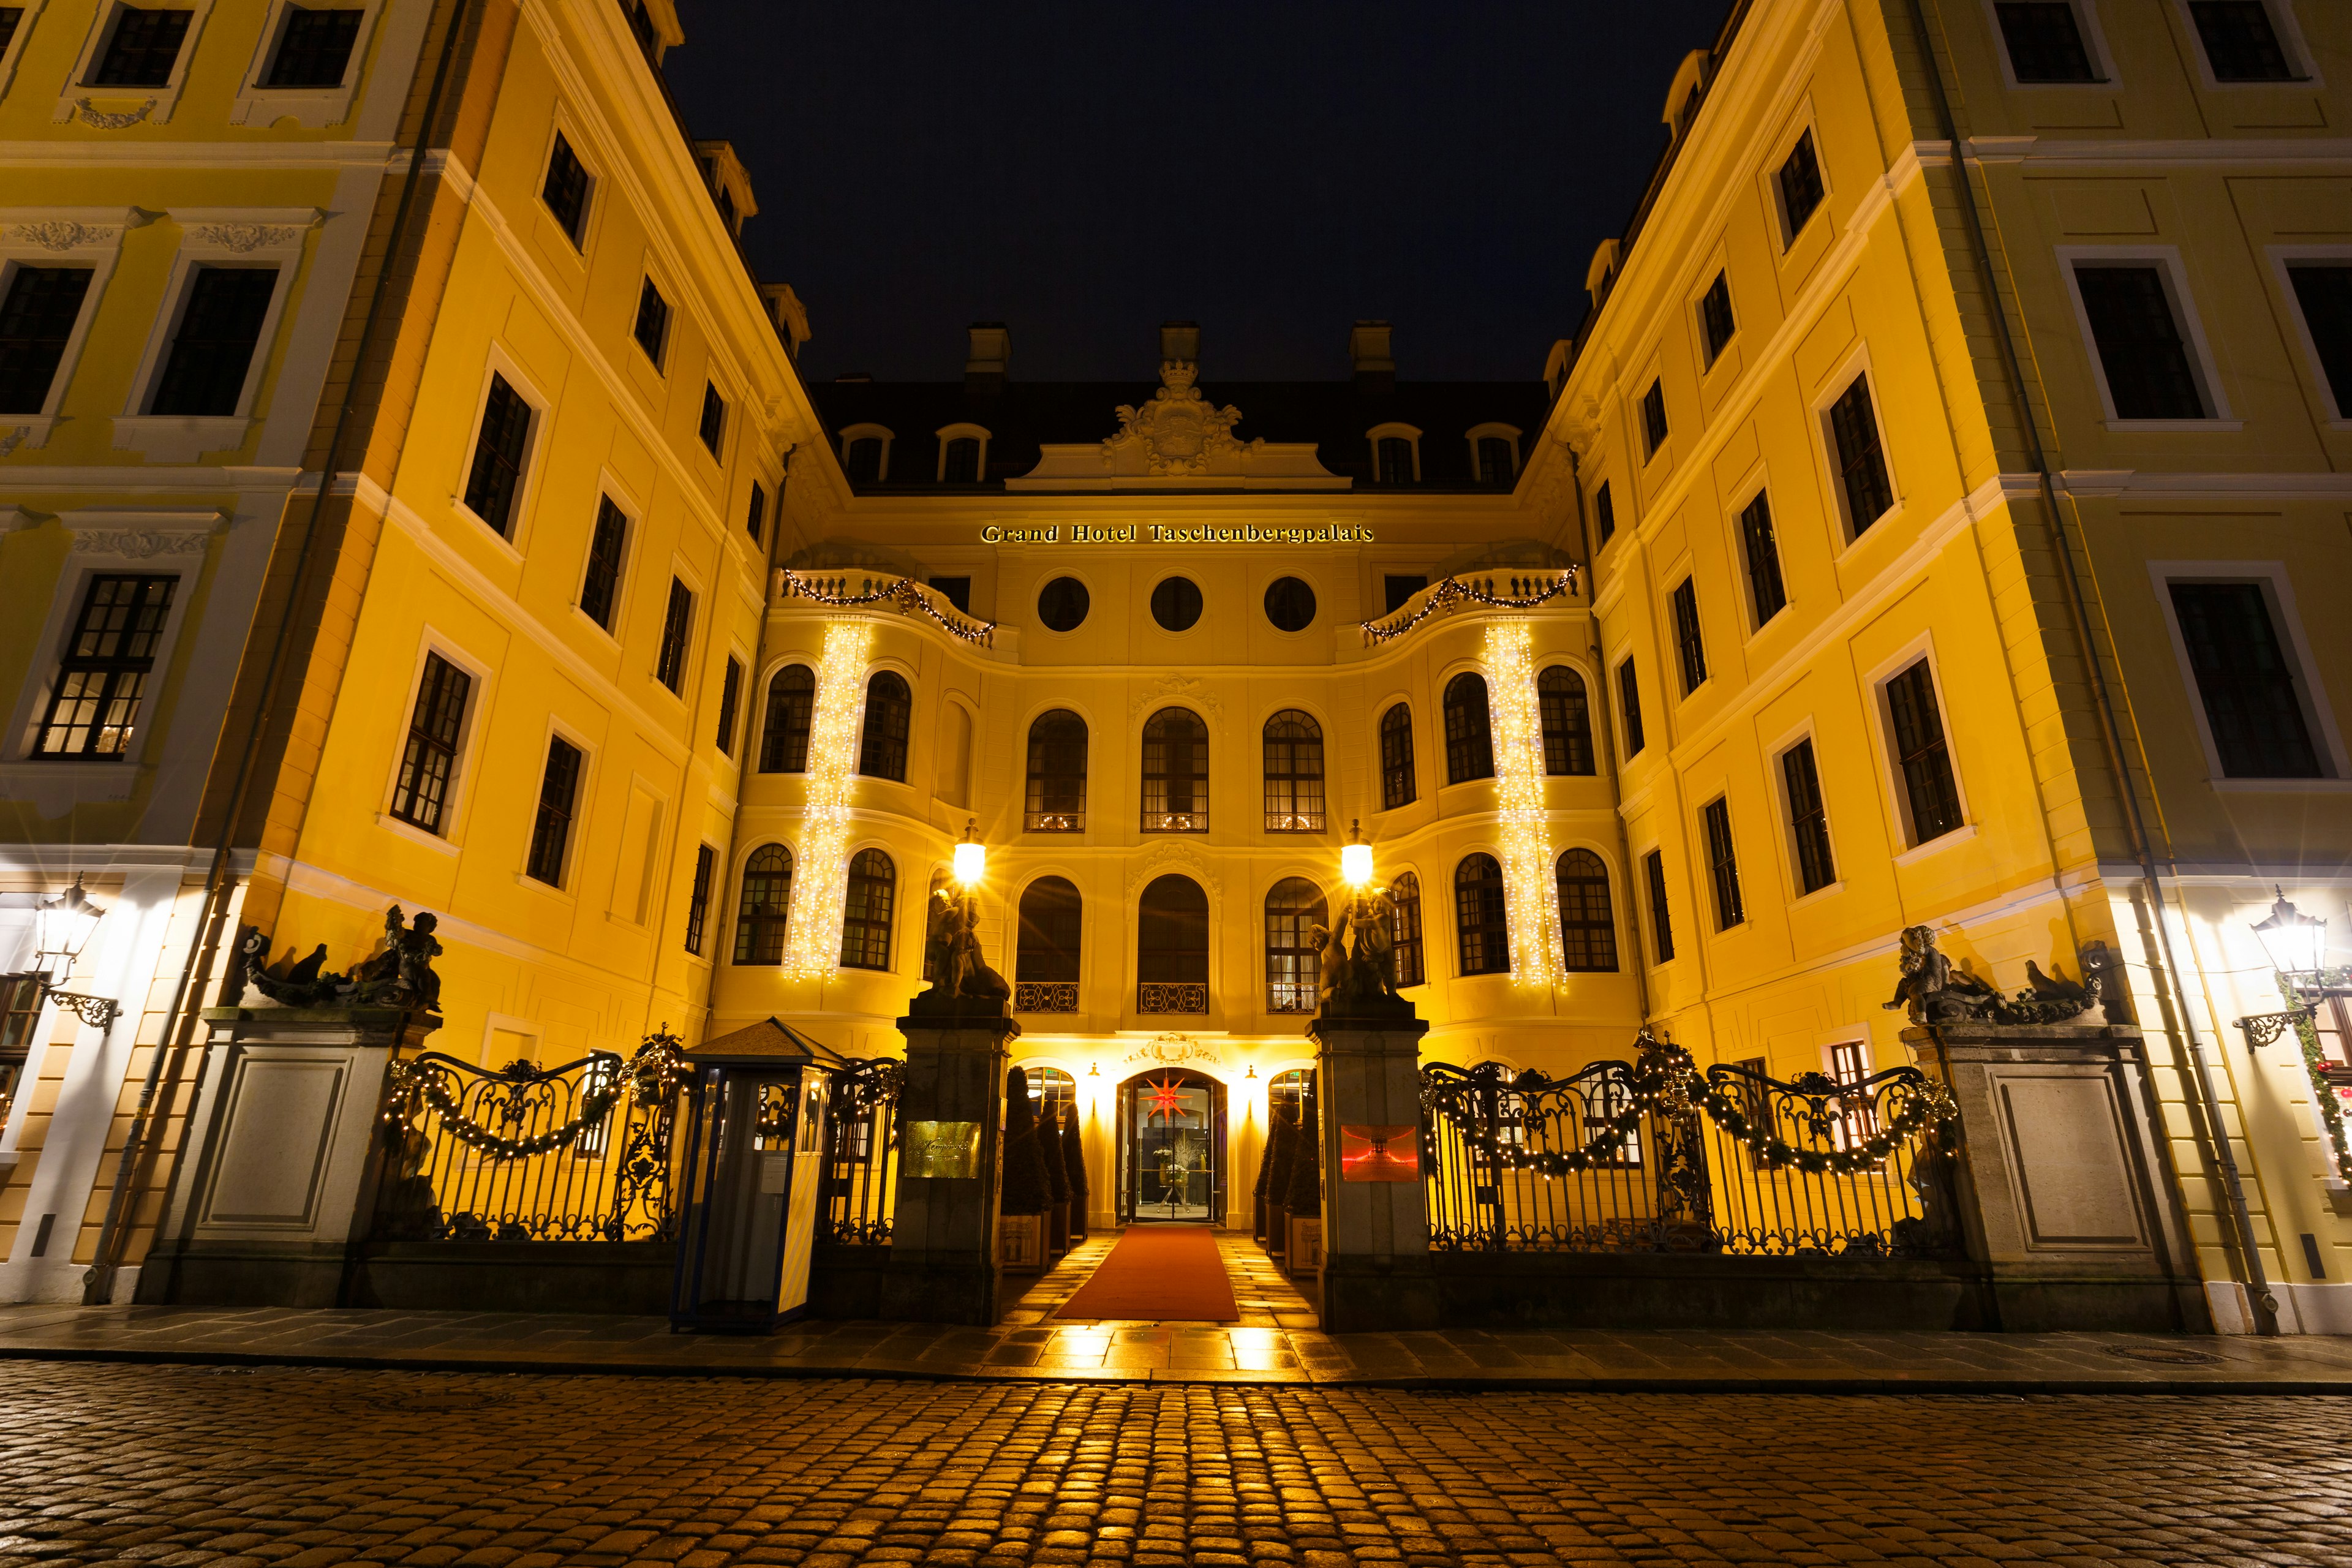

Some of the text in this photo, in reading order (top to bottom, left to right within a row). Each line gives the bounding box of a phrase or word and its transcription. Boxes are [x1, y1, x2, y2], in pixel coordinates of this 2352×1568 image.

[981, 524, 1373, 543] Grand Hotel Taschenbergpalais
